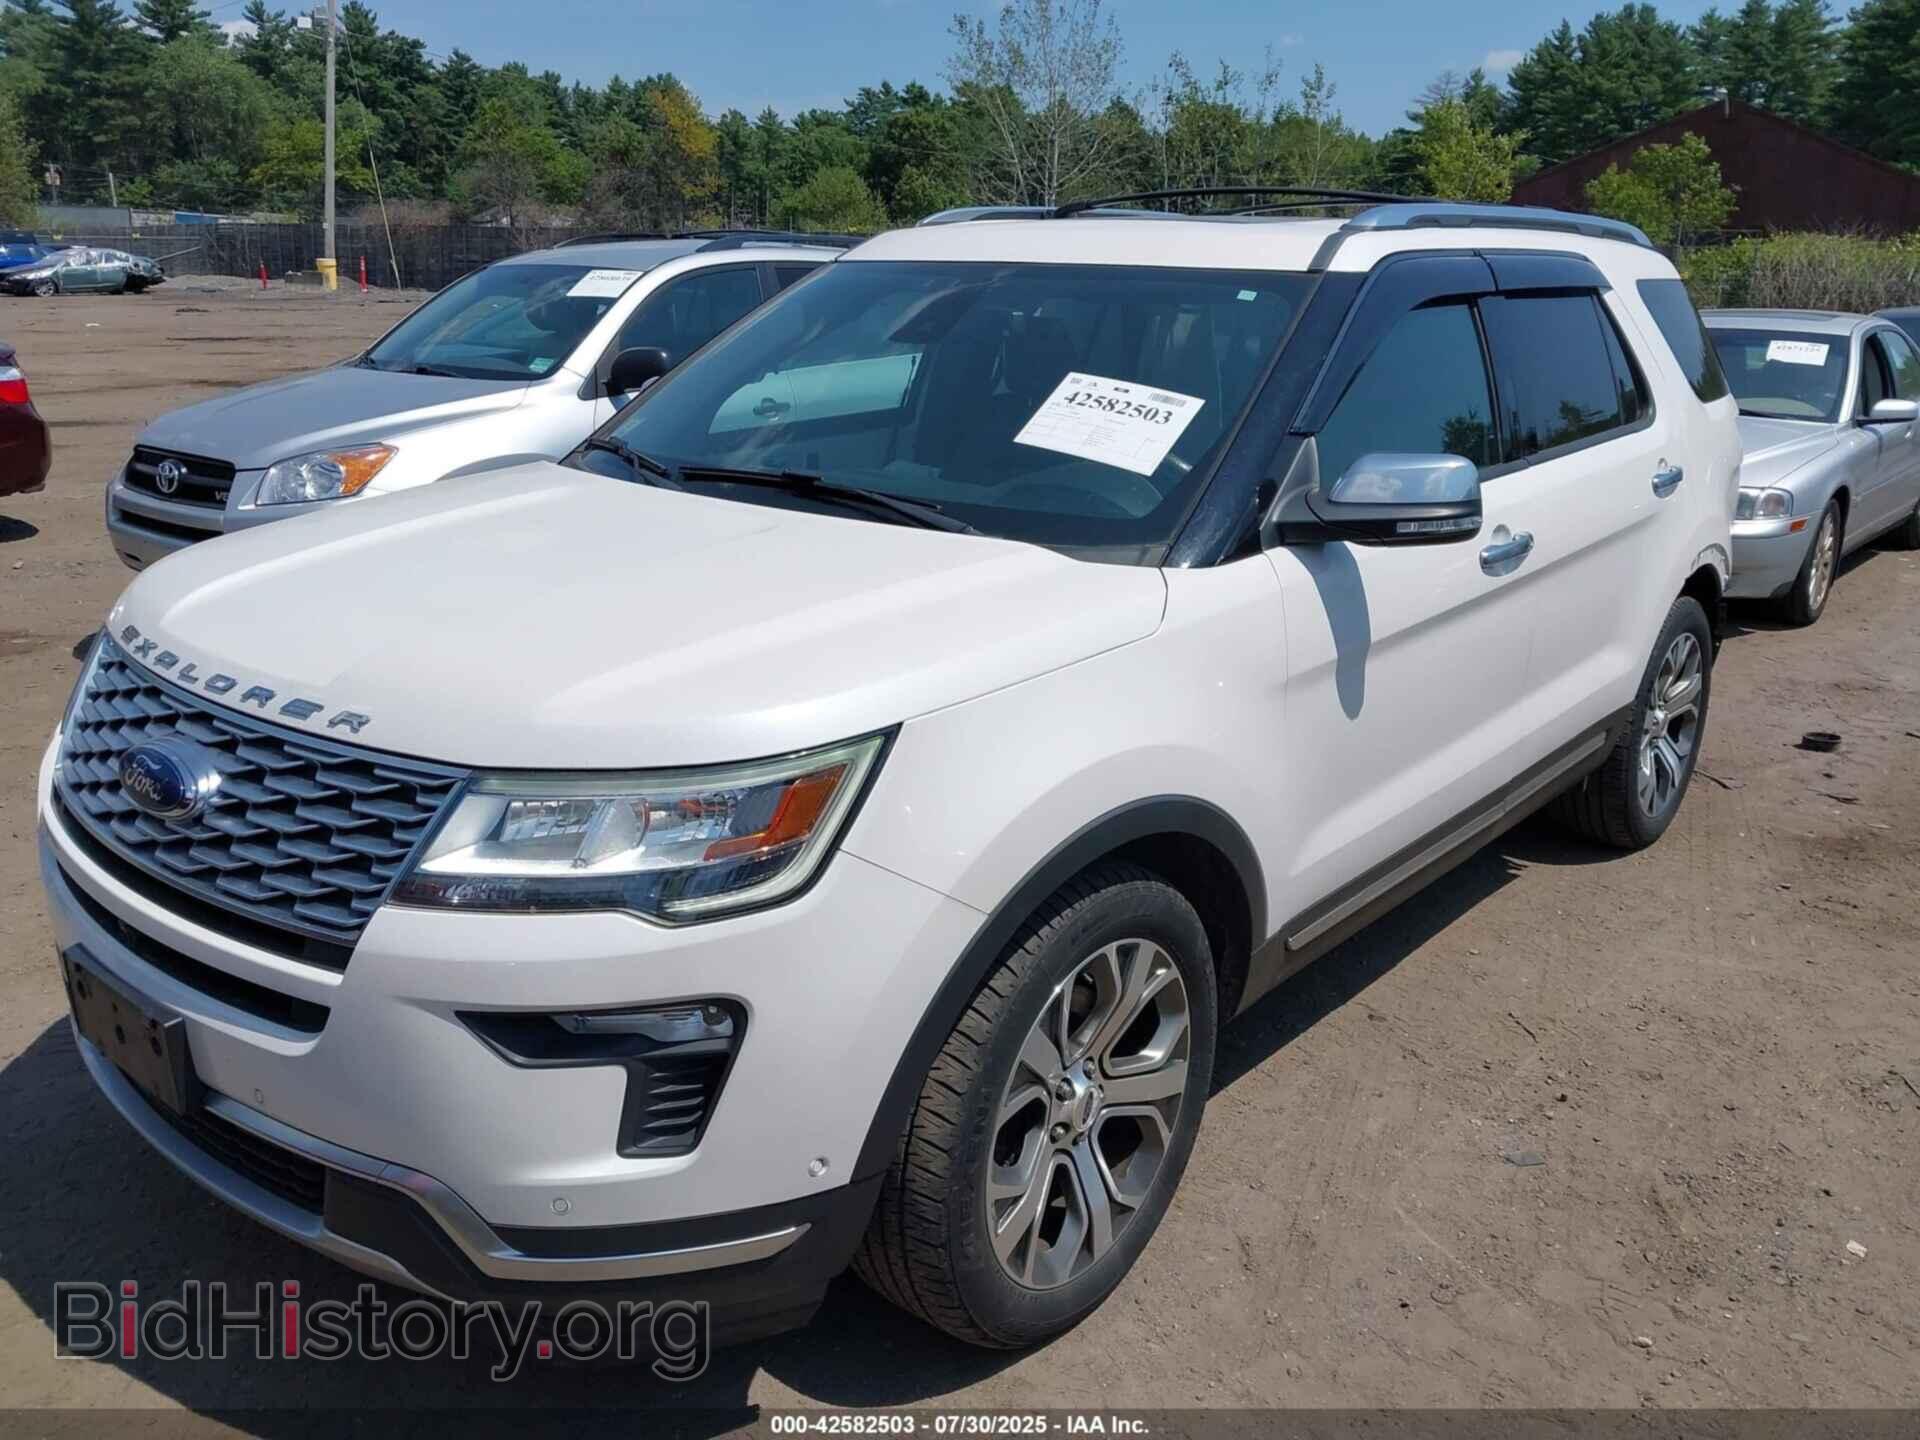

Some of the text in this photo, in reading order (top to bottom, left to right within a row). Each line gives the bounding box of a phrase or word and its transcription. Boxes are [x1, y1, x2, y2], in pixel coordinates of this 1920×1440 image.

[1063, 391, 1173, 425] 42582503
[120, 624, 371, 734] EXPLORER
[123, 753, 168, 801] Ford
